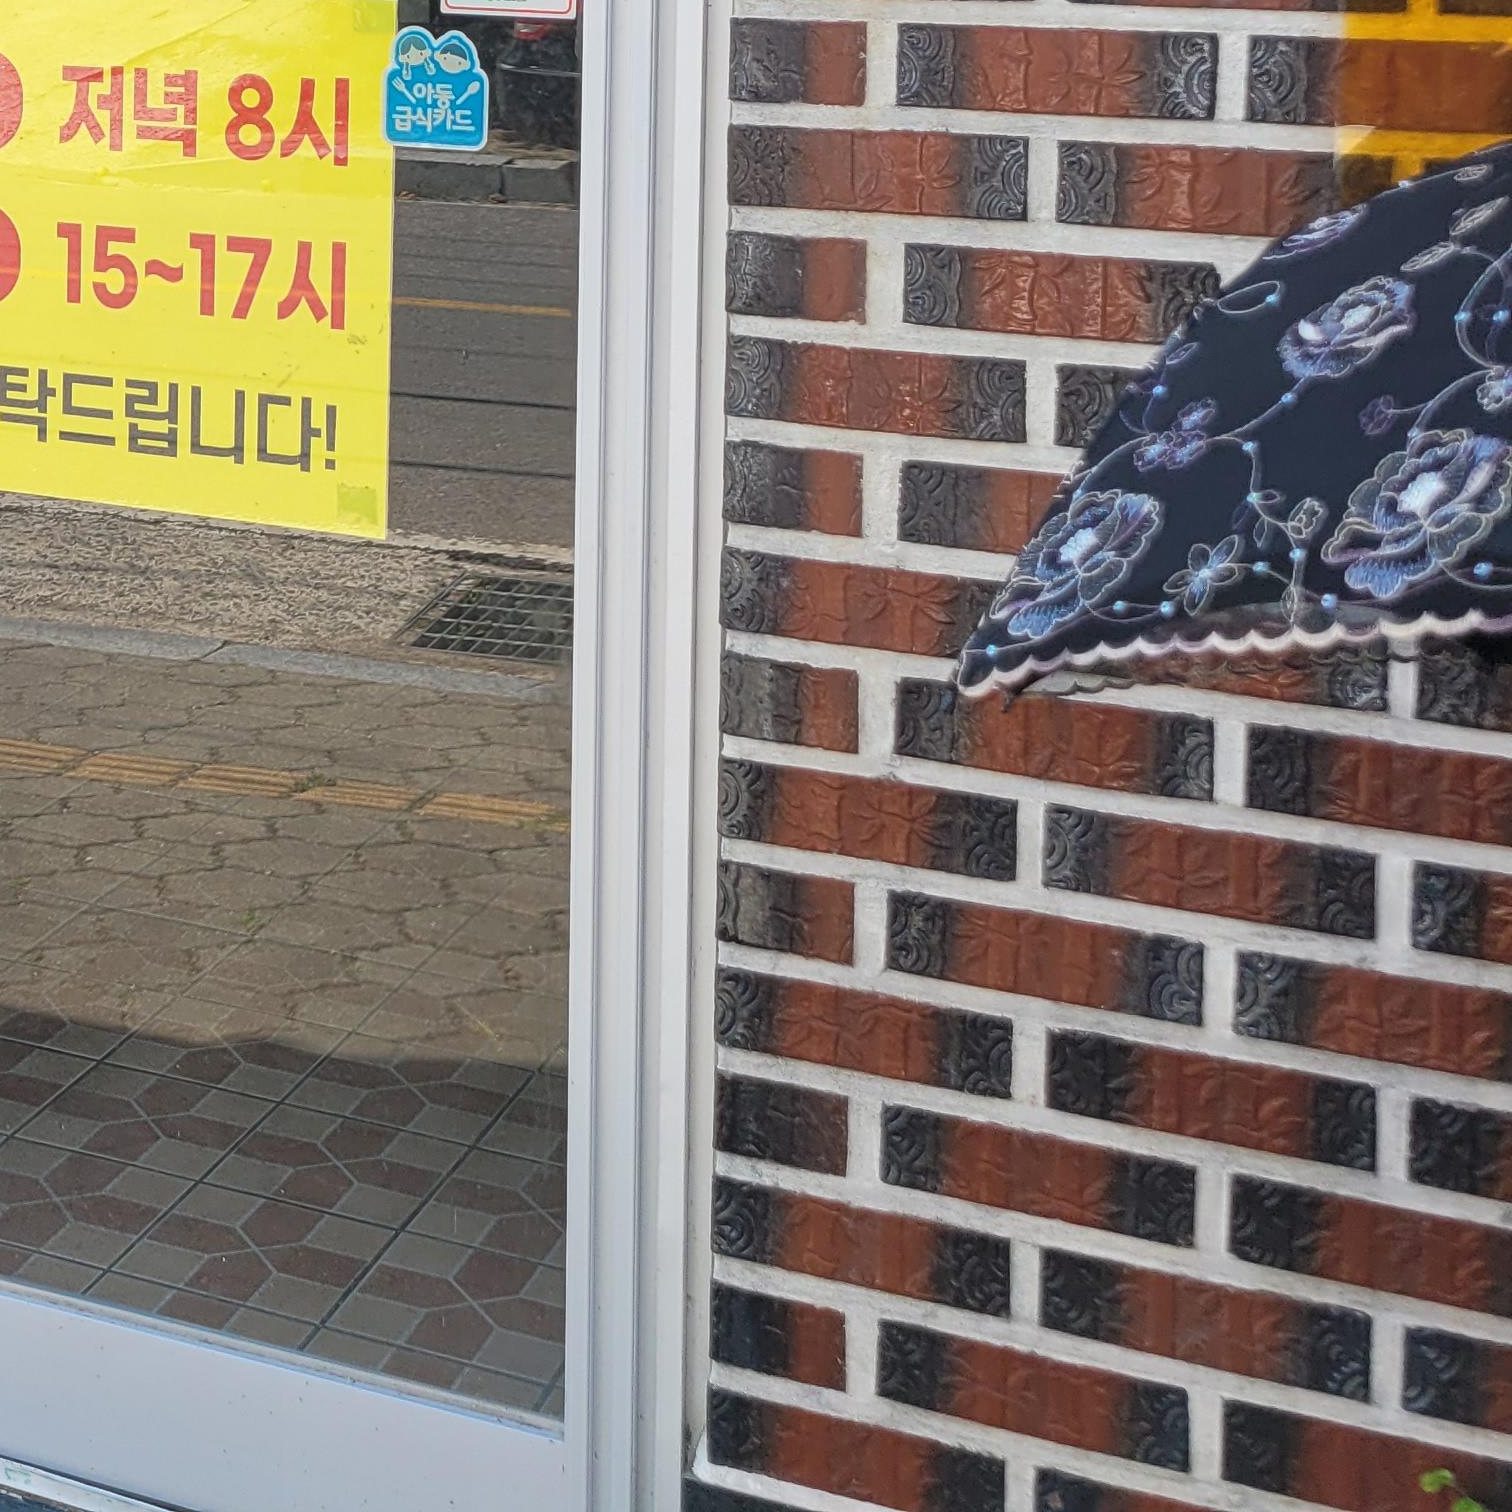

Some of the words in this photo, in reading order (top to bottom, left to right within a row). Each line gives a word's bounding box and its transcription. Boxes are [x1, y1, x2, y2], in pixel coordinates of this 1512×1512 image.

[60, 66, 197, 157] 저녁
[225, 74, 349, 166] 8시
[391, 105, 476, 133] 급식카드
[413, 82, 455, 109] 아동
[57, 223, 346, 330] 15~17시
